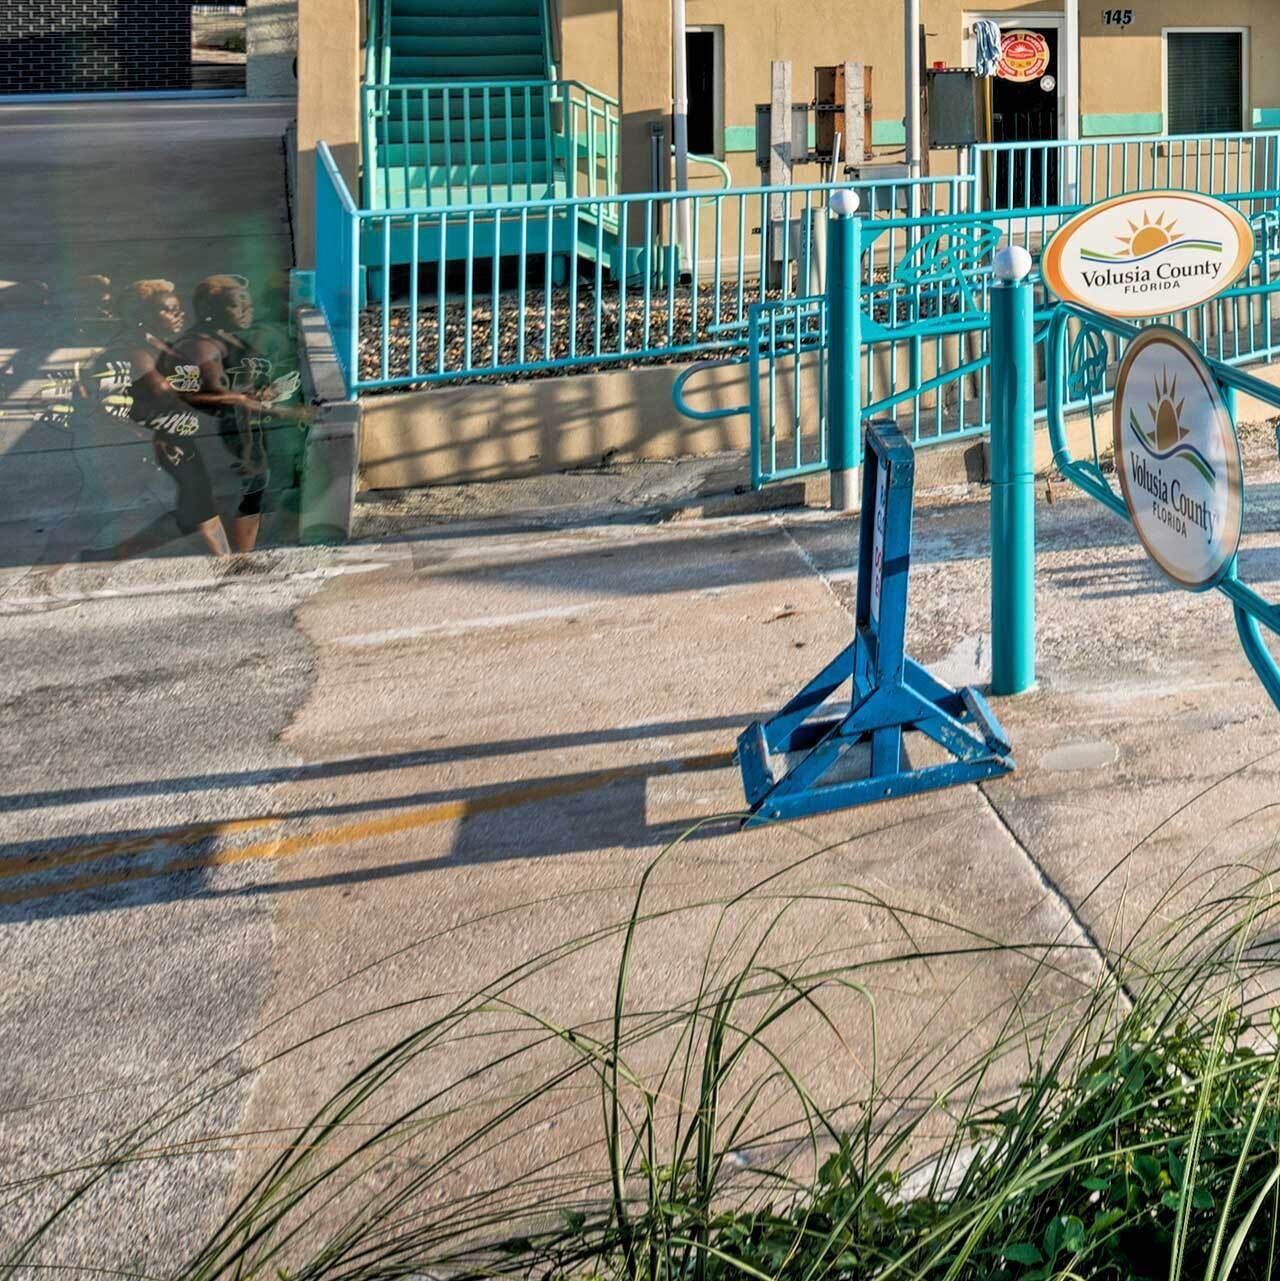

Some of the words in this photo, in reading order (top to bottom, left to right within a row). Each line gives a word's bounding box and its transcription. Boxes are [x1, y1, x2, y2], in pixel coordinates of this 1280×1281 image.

[1104, 10, 1133, 25] 145
[1081, 265, 1151, 288] Volusia
[1156, 260, 1222, 280] County
[1124, 280, 1181, 294] FLORIDA
[1130, 451, 1168, 505] Volusia
[1171, 479, 1214, 545] County
[1152, 501, 1188, 538] FLORIDA
